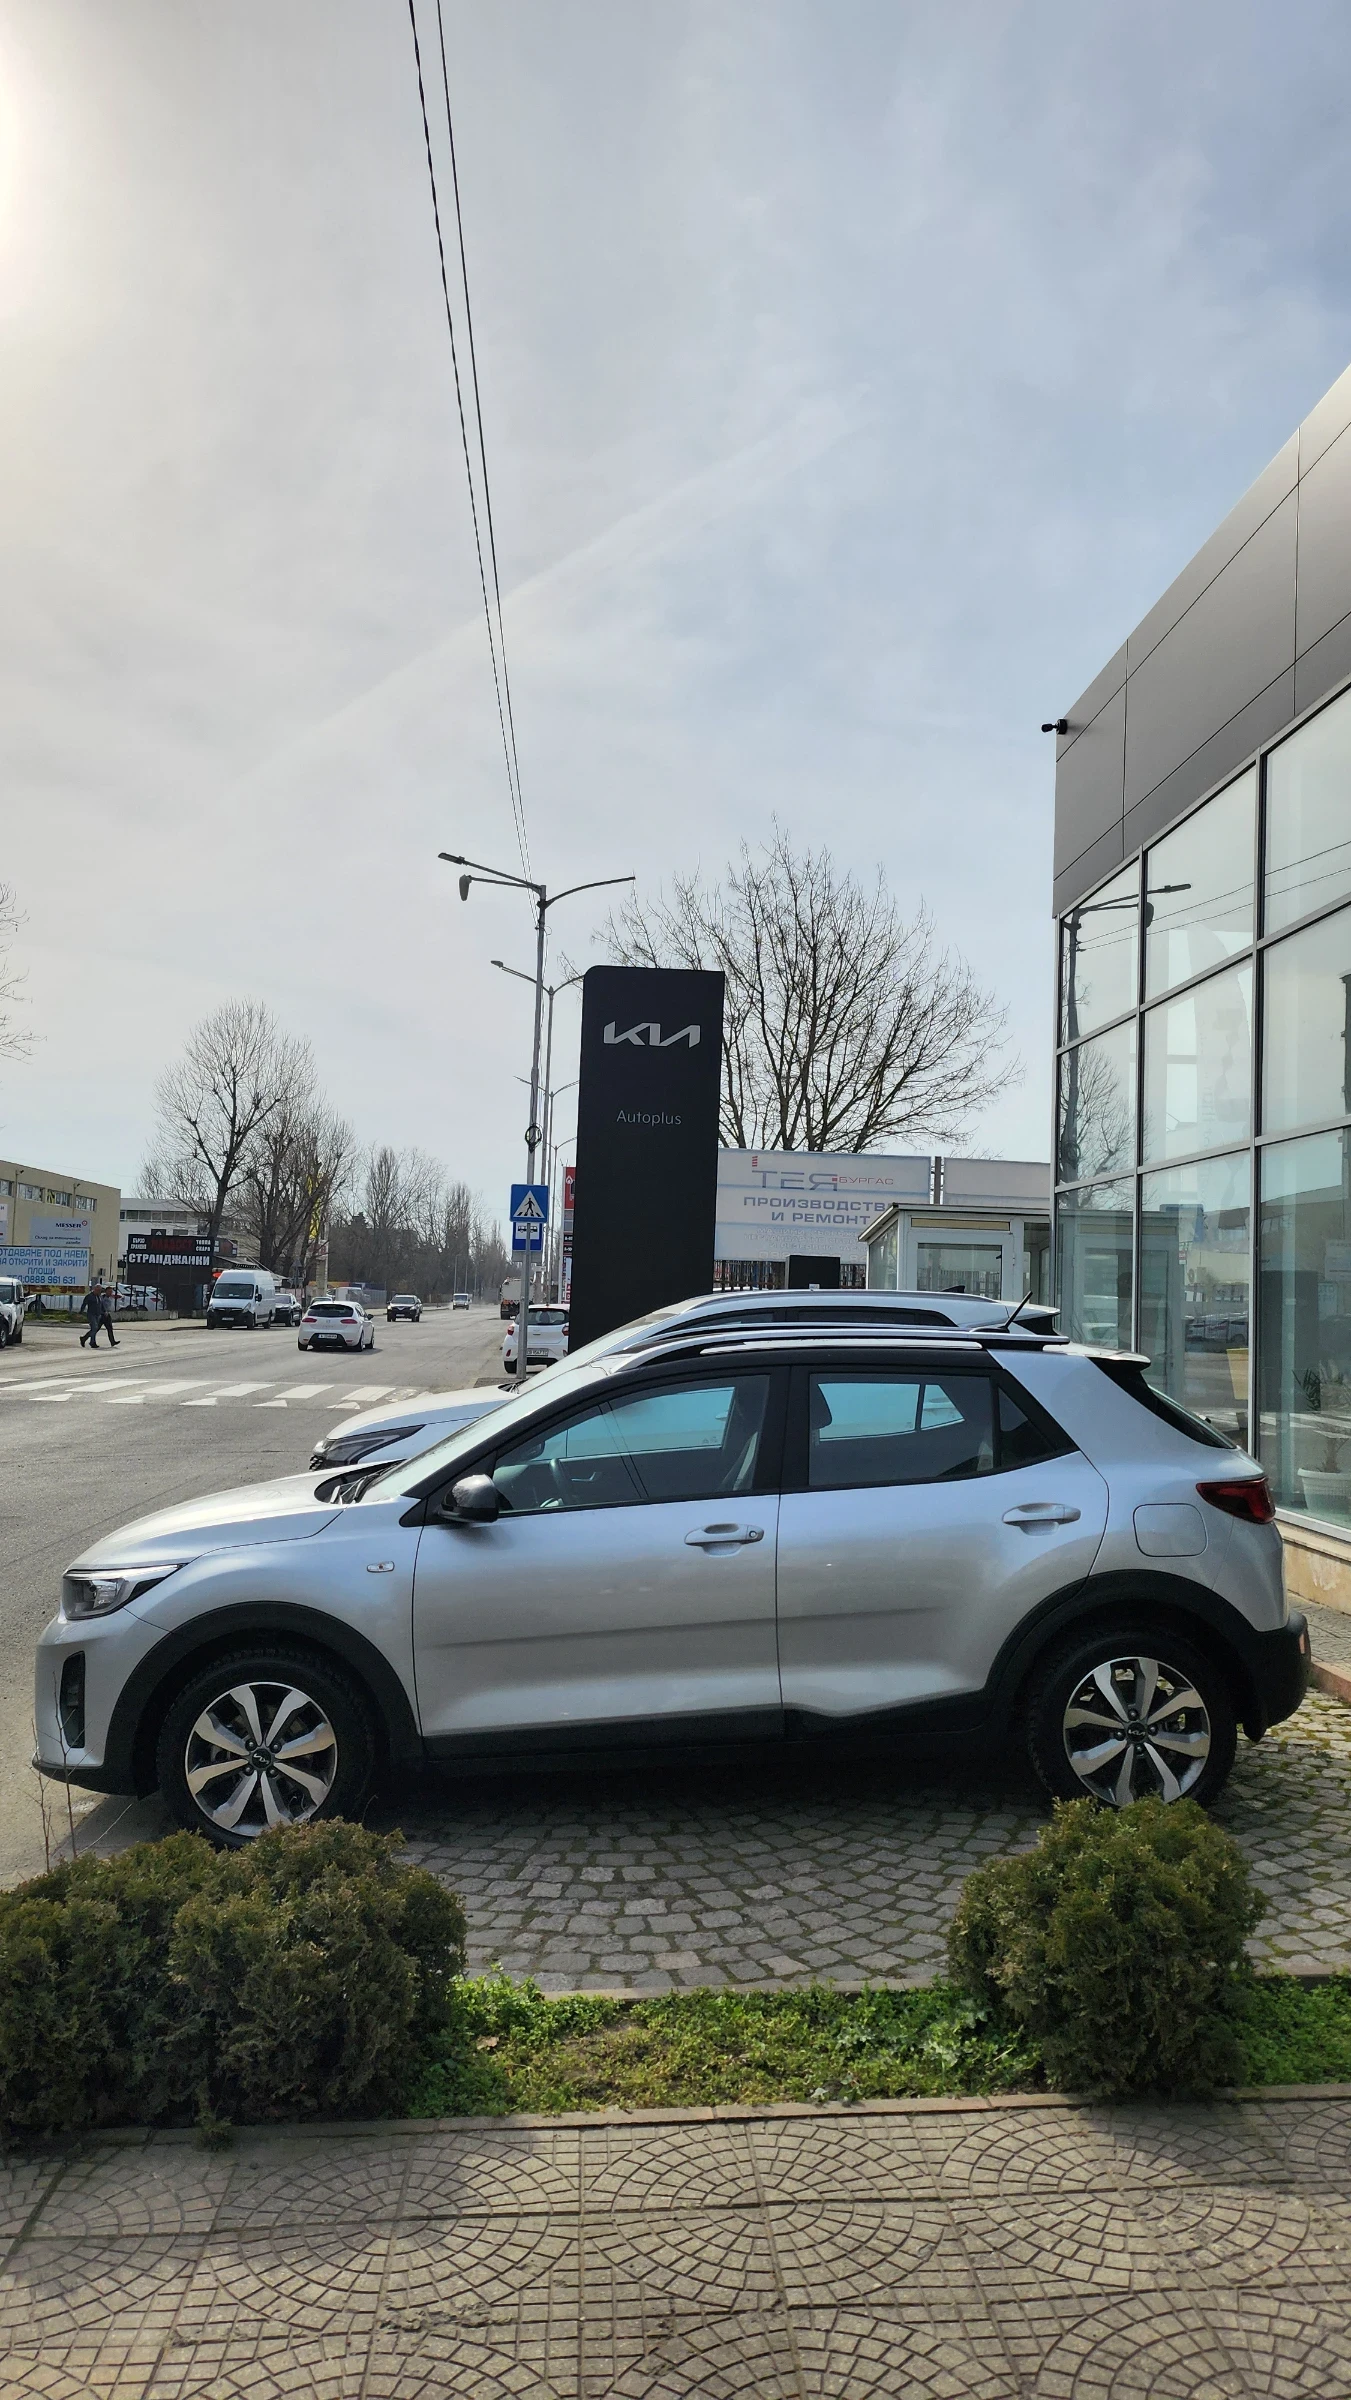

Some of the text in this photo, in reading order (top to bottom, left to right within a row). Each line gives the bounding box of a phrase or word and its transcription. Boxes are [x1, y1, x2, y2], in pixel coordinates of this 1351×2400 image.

[604, 1021, 700, 1048] KIA
[617, 1110, 682, 1127] Autoplus
[771, 1212, 870, 1225] И РЕМОНТ
[44, 1249, 62, 1258] ПОД
[64, 1250, 88, 1258] НАЕМ
[128, 1253, 210, 1265] СТРАНДЖАНКИ
[9, 1258, 43, 1266] ОТКРИТИ
[52, 1259, 88, 1267] ЗАКРИТИ
[47, 1276, 60, 1284] 961
[63, 1276, 76, 1284] 631
